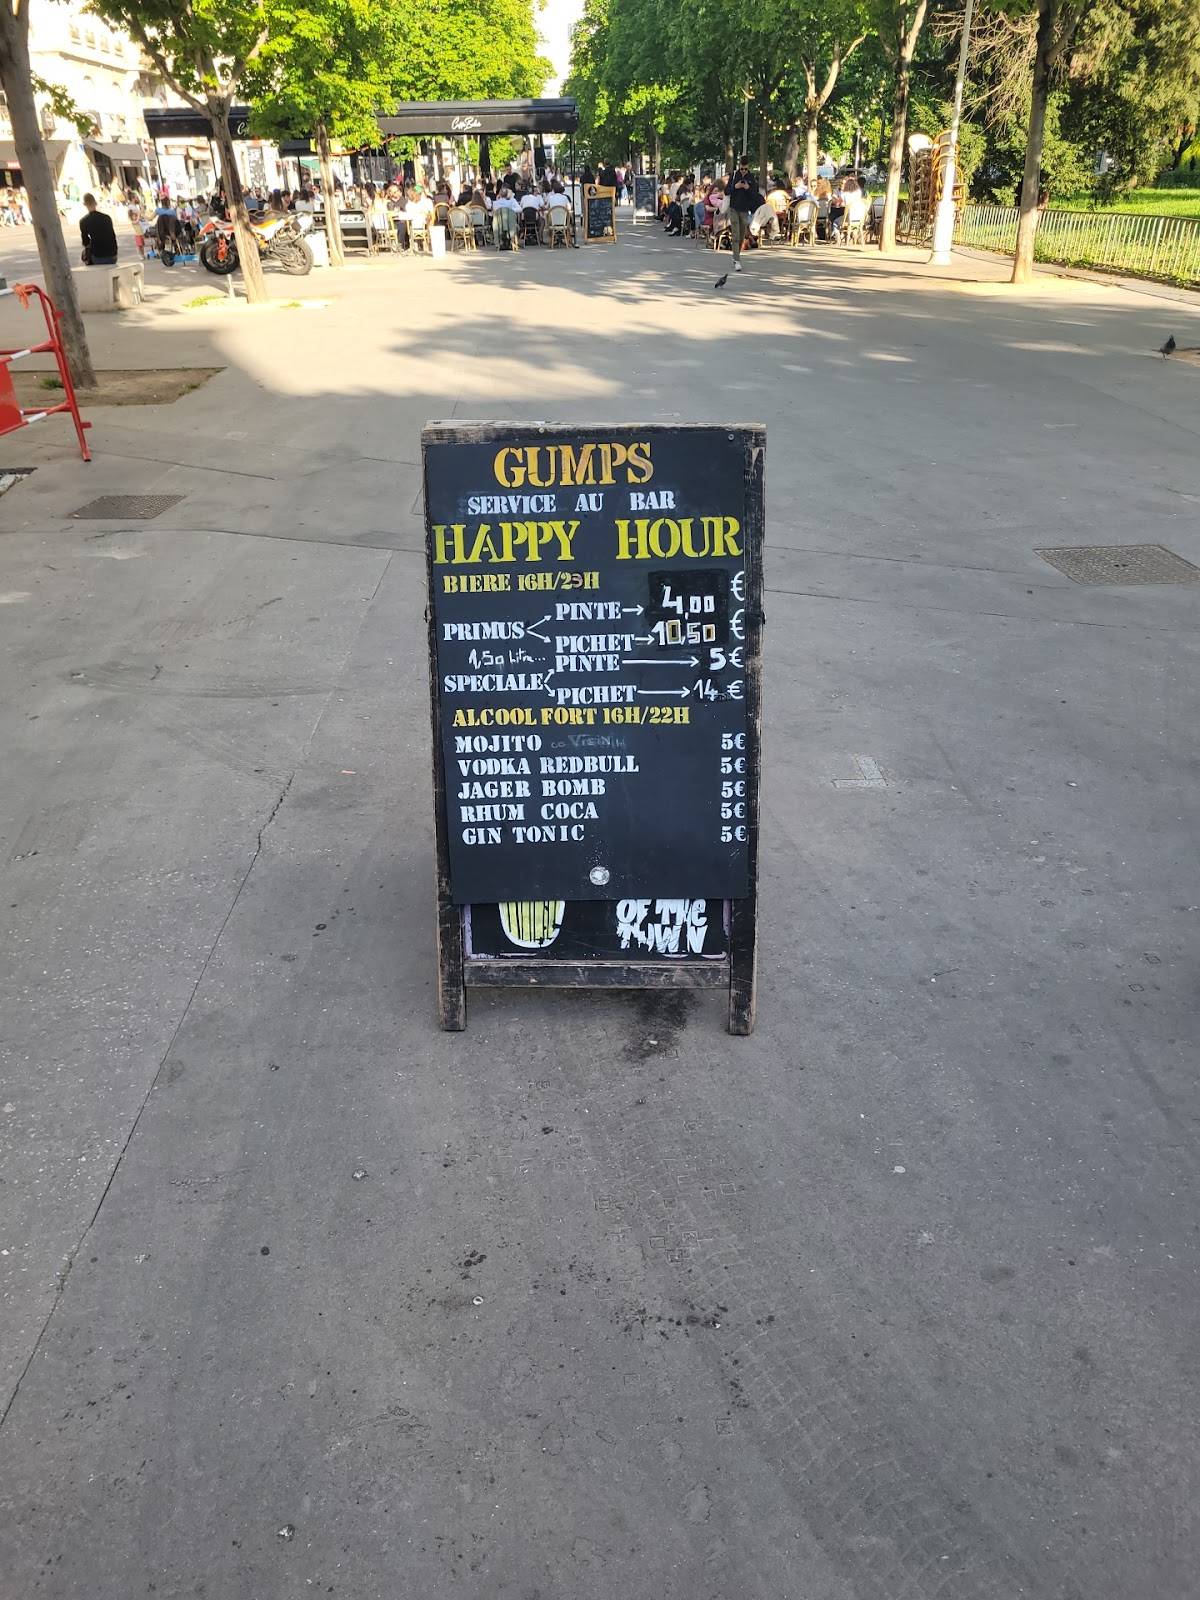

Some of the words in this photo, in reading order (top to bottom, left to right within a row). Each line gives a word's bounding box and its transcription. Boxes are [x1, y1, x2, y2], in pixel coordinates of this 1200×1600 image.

[494, 442, 654, 488] GUMPS
[467, 494, 556, 515] SERVICE
[574, 493, 603, 512] AU
[630, 490, 676, 511] BAR
[432, 520, 580, 564] HAPPY
[614, 516, 743, 560] HOUR
[443, 573, 511, 593] BIERE
[555, 602, 622, 621] PINTE
[661, 583, 715, 620] 4,00
[443, 621, 525, 641] PRIMUS
[556, 634, 635, 654] PICHET
[651, 619, 716, 646] 10,50
[555, 653, 620, 673] PINTE
[444, 673, 544, 693] SPECIALE
[557, 685, 636, 705] PICHET
[452, 709, 537, 728] ALCOOL
[540, 707, 597, 727] FORT
[603, 706, 690, 725] 16H/22H
[455, 734, 542, 753] MOJITO
[721, 733, 746, 751] 5€
[457, 758, 531, 777] VODKA
[539, 755, 639, 774] REDBULL
[720, 757, 746, 774] 5€
[458, 780, 531, 800] JAGER
[541, 778, 606, 798] BOMB
[721, 781, 746, 798] 5€
[460, 804, 525, 823] RHUM
[540, 802, 599, 820] COCA
[720, 802, 746, 820] 5€
[462, 827, 501, 846] GIN
[513, 824, 585, 844] TONIC
[720, 825, 747, 843] 5€
[616, 899, 652, 926] OF
